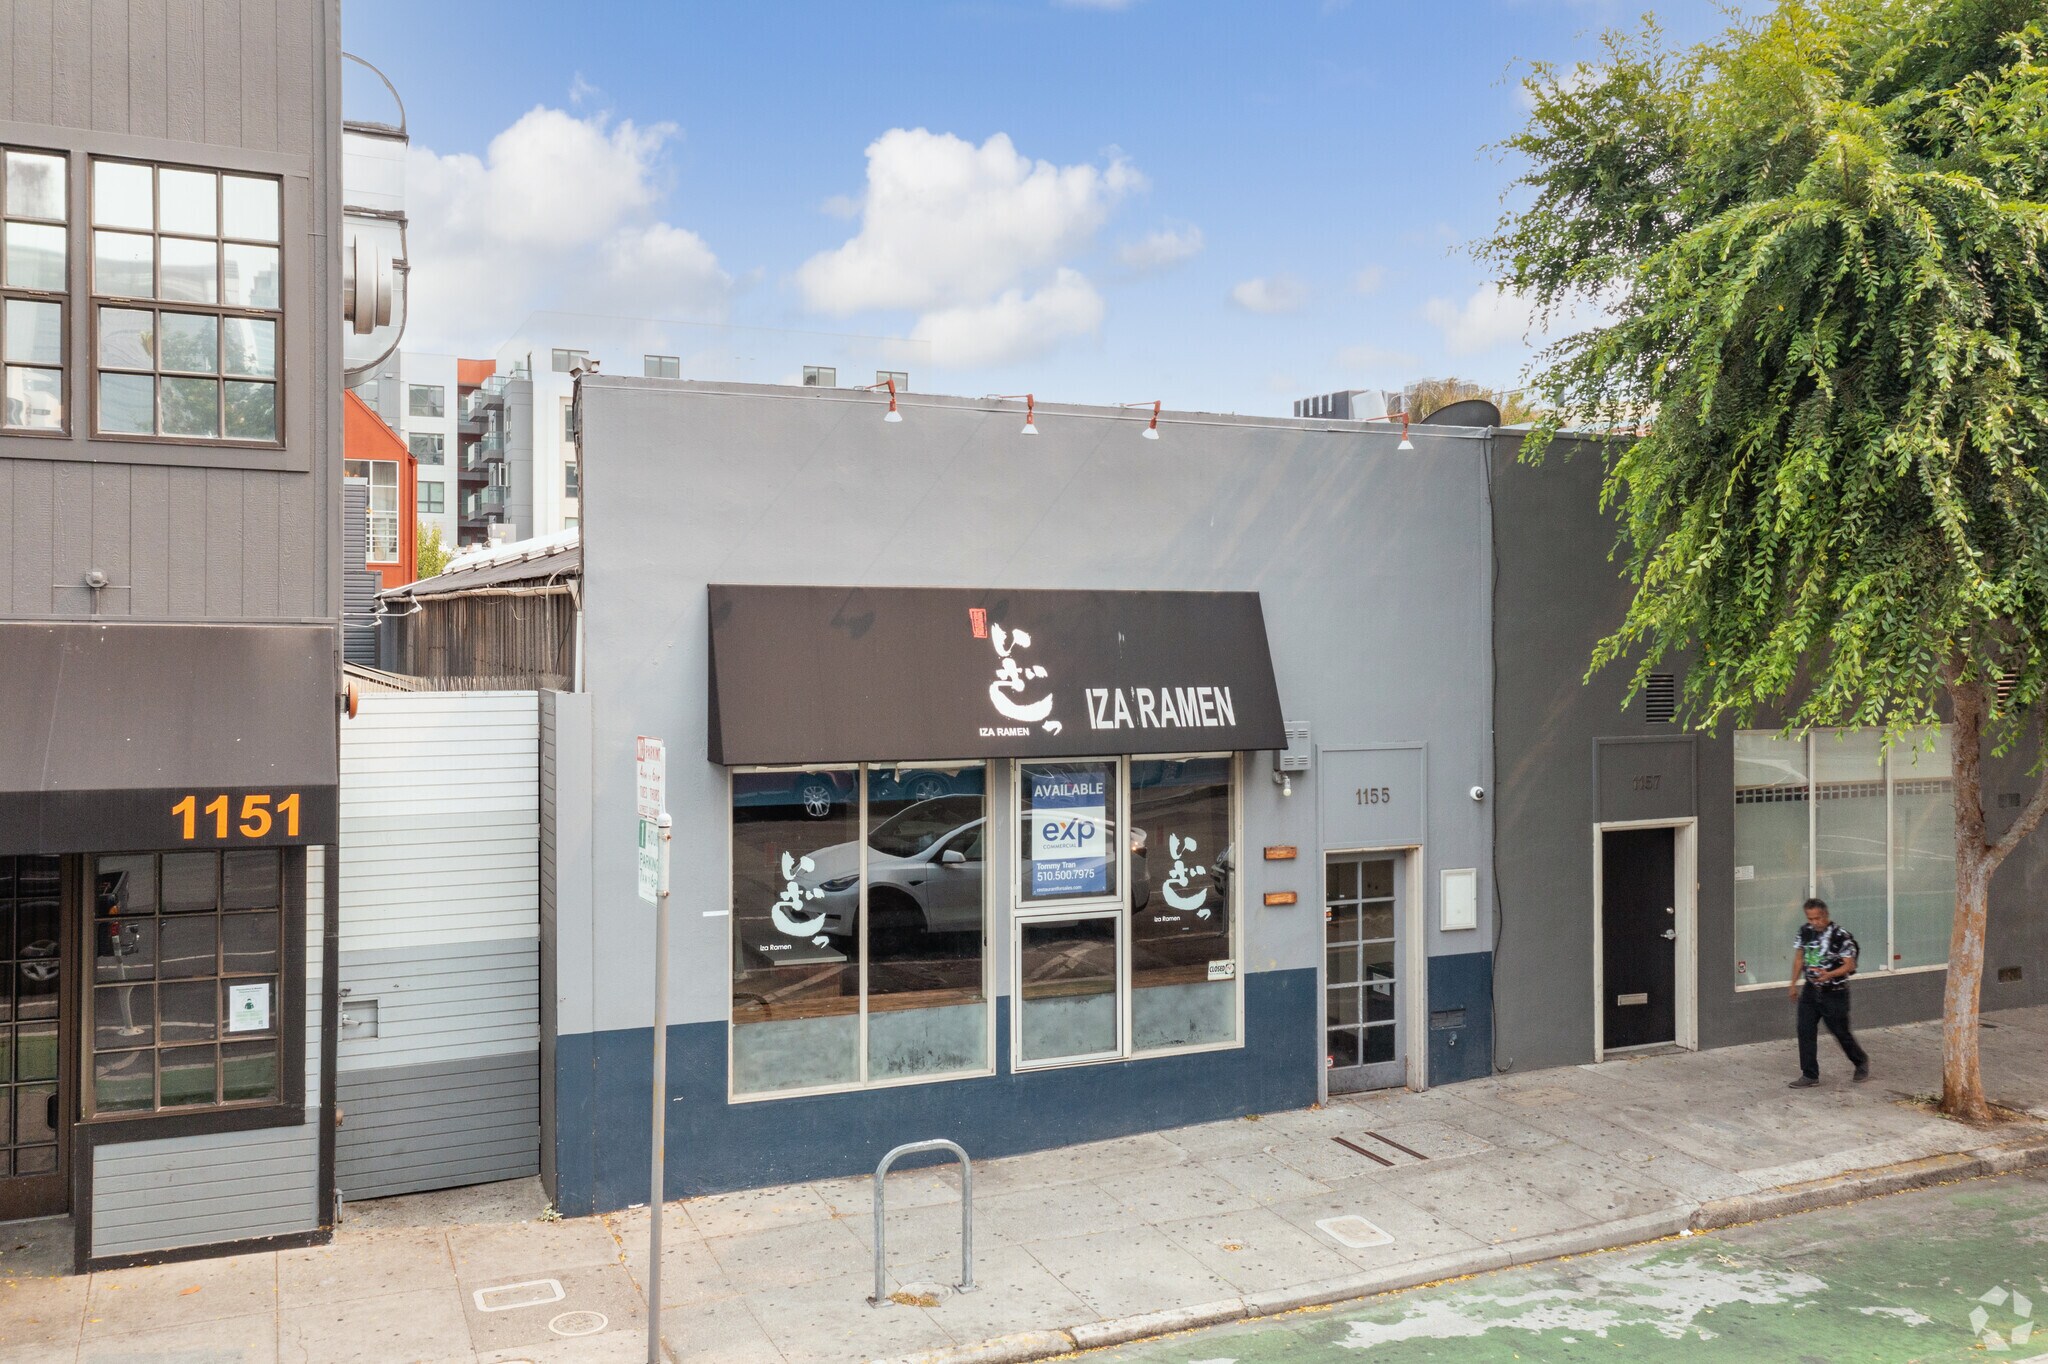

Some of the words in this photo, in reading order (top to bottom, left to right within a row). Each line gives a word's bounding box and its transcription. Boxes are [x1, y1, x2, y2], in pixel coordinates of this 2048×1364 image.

[1085, 688, 1134, 729] IZA
[1136, 687, 1236, 729] RAMEN
[980, 727, 995, 736] IZA
[997, 727, 1030, 736] RAMEN
[1034, 783, 1103, 797] AVAILABLE
[1633, 775, 1662, 791] 1157
[1355, 788, 1390, 805] 1155
[172, 793, 300, 839] 1151
[1037, 863, 1061, 871] Tommy
[1037, 869, 1095, 881] 510.500.7975
[769, 943, 792, 951] Ramen
